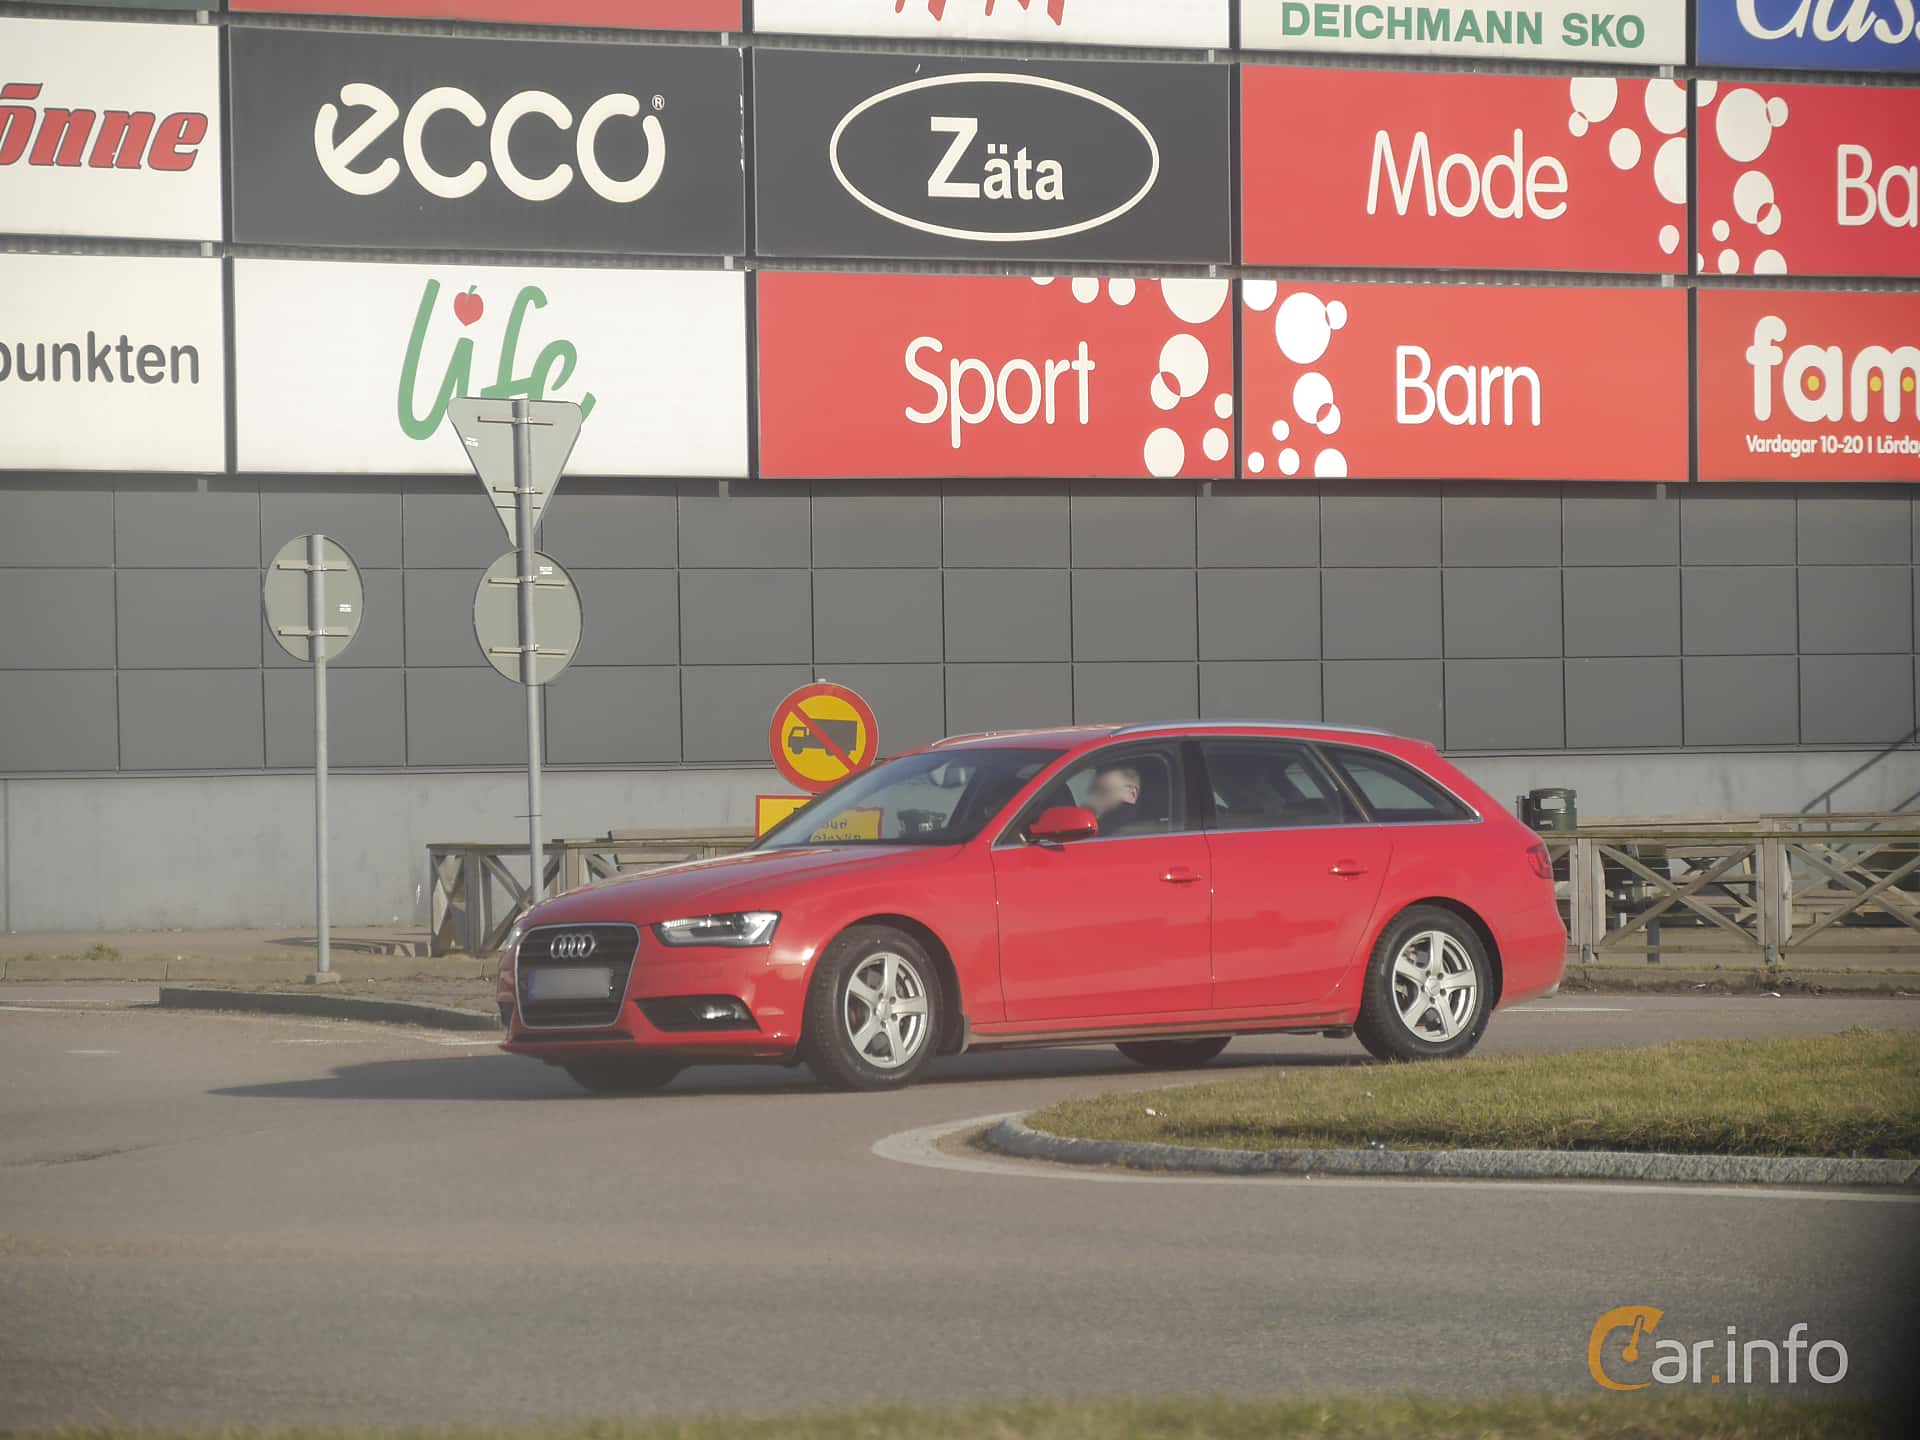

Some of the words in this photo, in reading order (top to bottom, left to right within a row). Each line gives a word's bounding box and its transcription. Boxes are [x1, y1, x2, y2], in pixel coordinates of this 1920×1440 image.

[1281, 2, 1543, 45] DEICHMANN
[1561, 12, 1645, 49] SKO
[928, 115, 1064, 201] Zäta
[1366, 127, 1568, 220] Mode
[904, 336, 1096, 449] Sport
[1395, 344, 1541, 427] Barn
[1745, 433, 1818, 458] Vardagar
[1820, 434, 1864, 454] 10-20
[1876, 433, 1920, 458] Lörda
